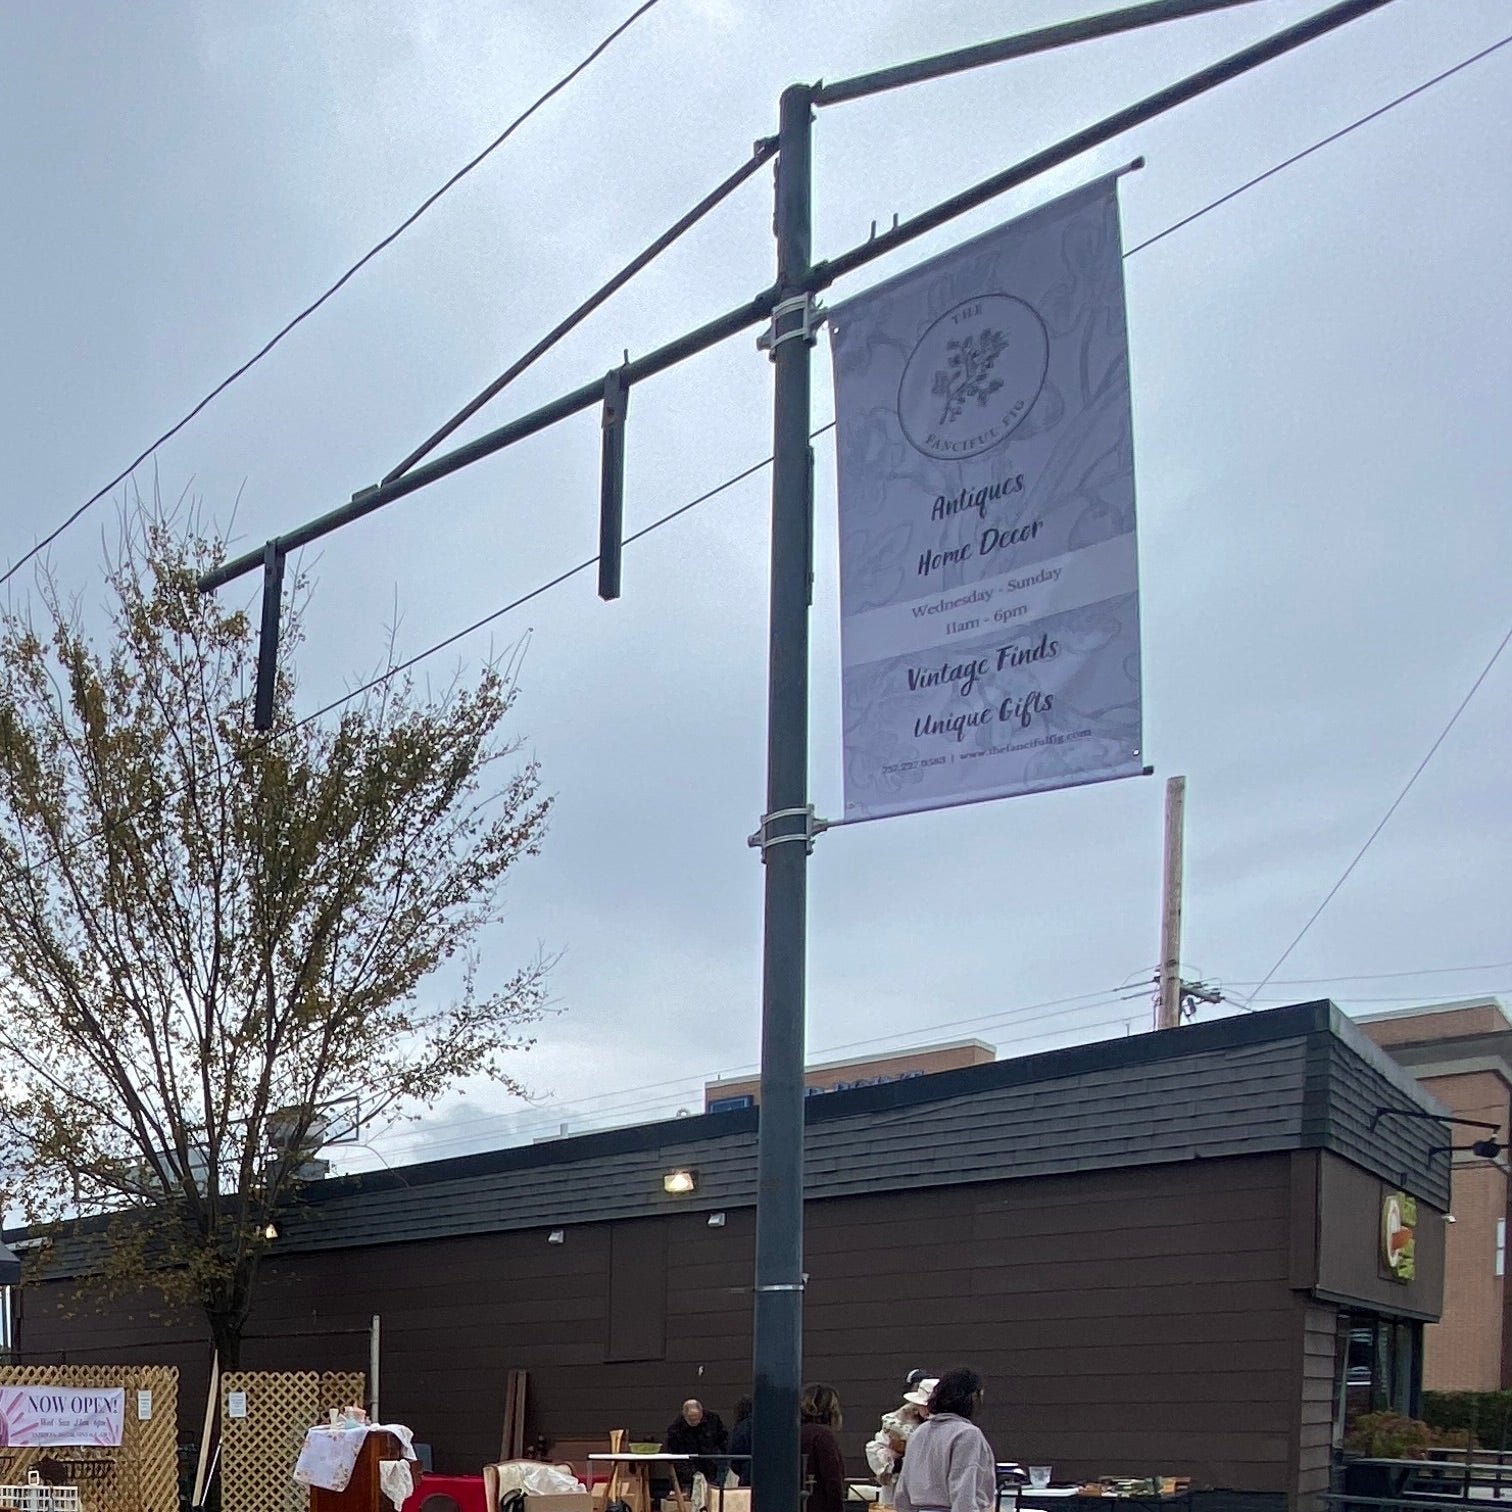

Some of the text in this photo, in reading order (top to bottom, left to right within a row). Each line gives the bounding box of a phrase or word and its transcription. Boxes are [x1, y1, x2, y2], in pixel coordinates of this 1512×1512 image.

[951, 303, 983, 325] THE
[925, 400, 1025, 452] FANCIFUL FIG
[930, 473, 1025, 521] Antiques
[917, 520, 1044, 576] Home Decor
[911, 588, 995, 619] Wednesday
[1007, 567, 1063, 593] Sunday
[945, 617, 980, 635] 11am
[993, 604, 1028, 626] 6pm
[907, 634, 1060, 697] Vintage Finds
[913, 691, 1055, 742] Unique Gifts
[28, 1395, 65, 1413] NOW
[71, 1395, 119, 1414] OPEN!
